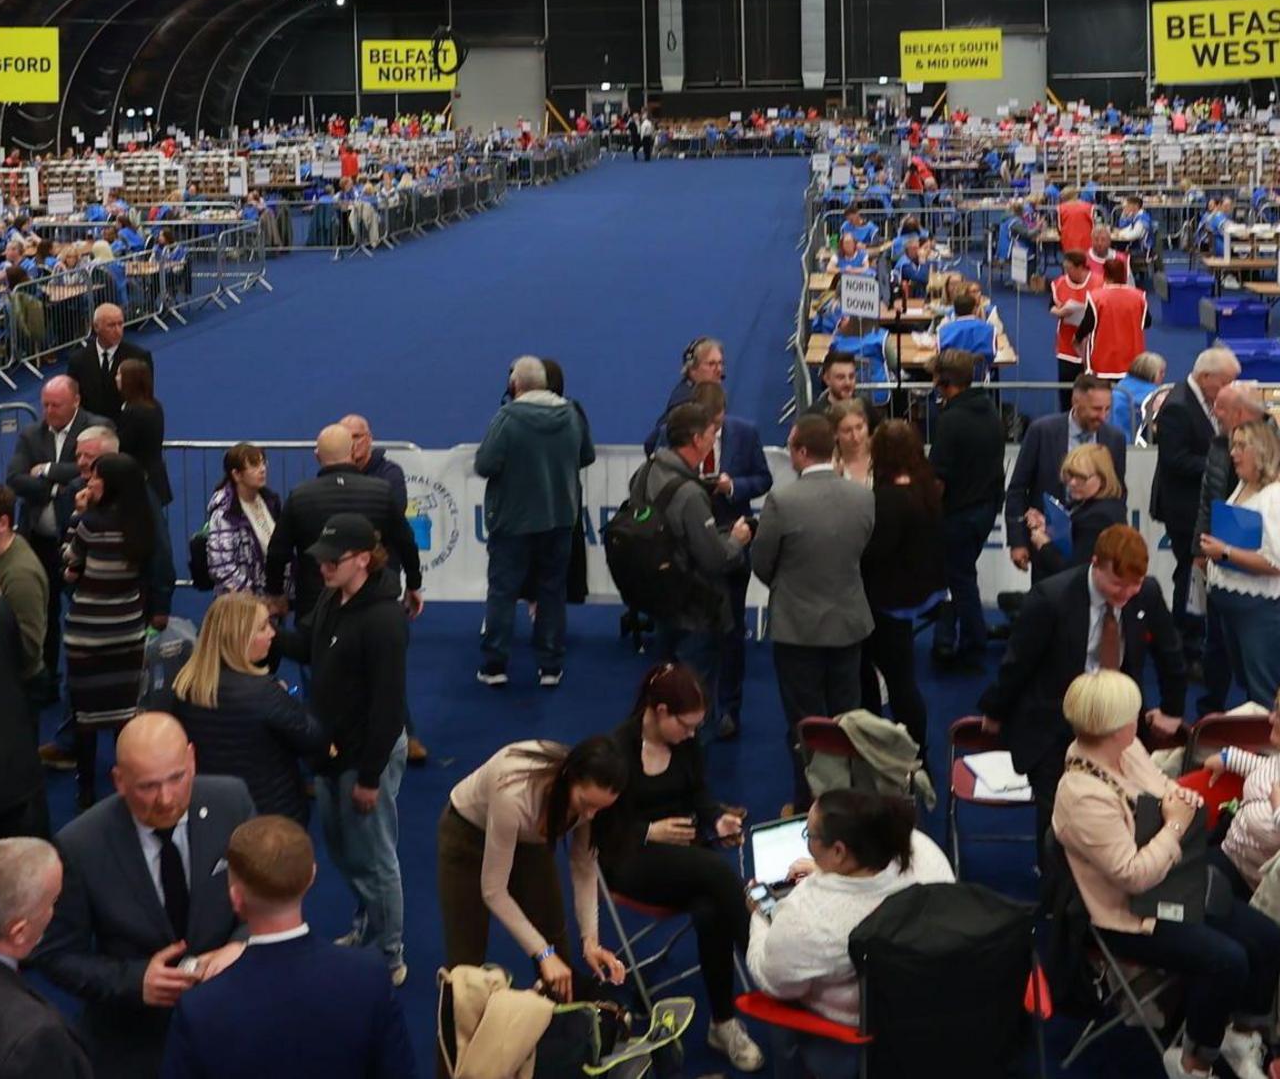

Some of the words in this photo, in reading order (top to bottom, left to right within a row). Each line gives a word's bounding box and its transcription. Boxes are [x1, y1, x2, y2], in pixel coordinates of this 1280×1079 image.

[904, 43, 956, 55] BELFAST
[960, 41, 999, 52] SOUTH
[1192, 39, 1280, 67] WEST
[915, 59, 924, 70] &
[927, 58, 949, 69] MID
[952, 57, 988, 69] DOWN
[379, 67, 441, 82] NORTH
[846, 279, 876, 292] NORTH
[846, 296, 875, 311] DOWN
